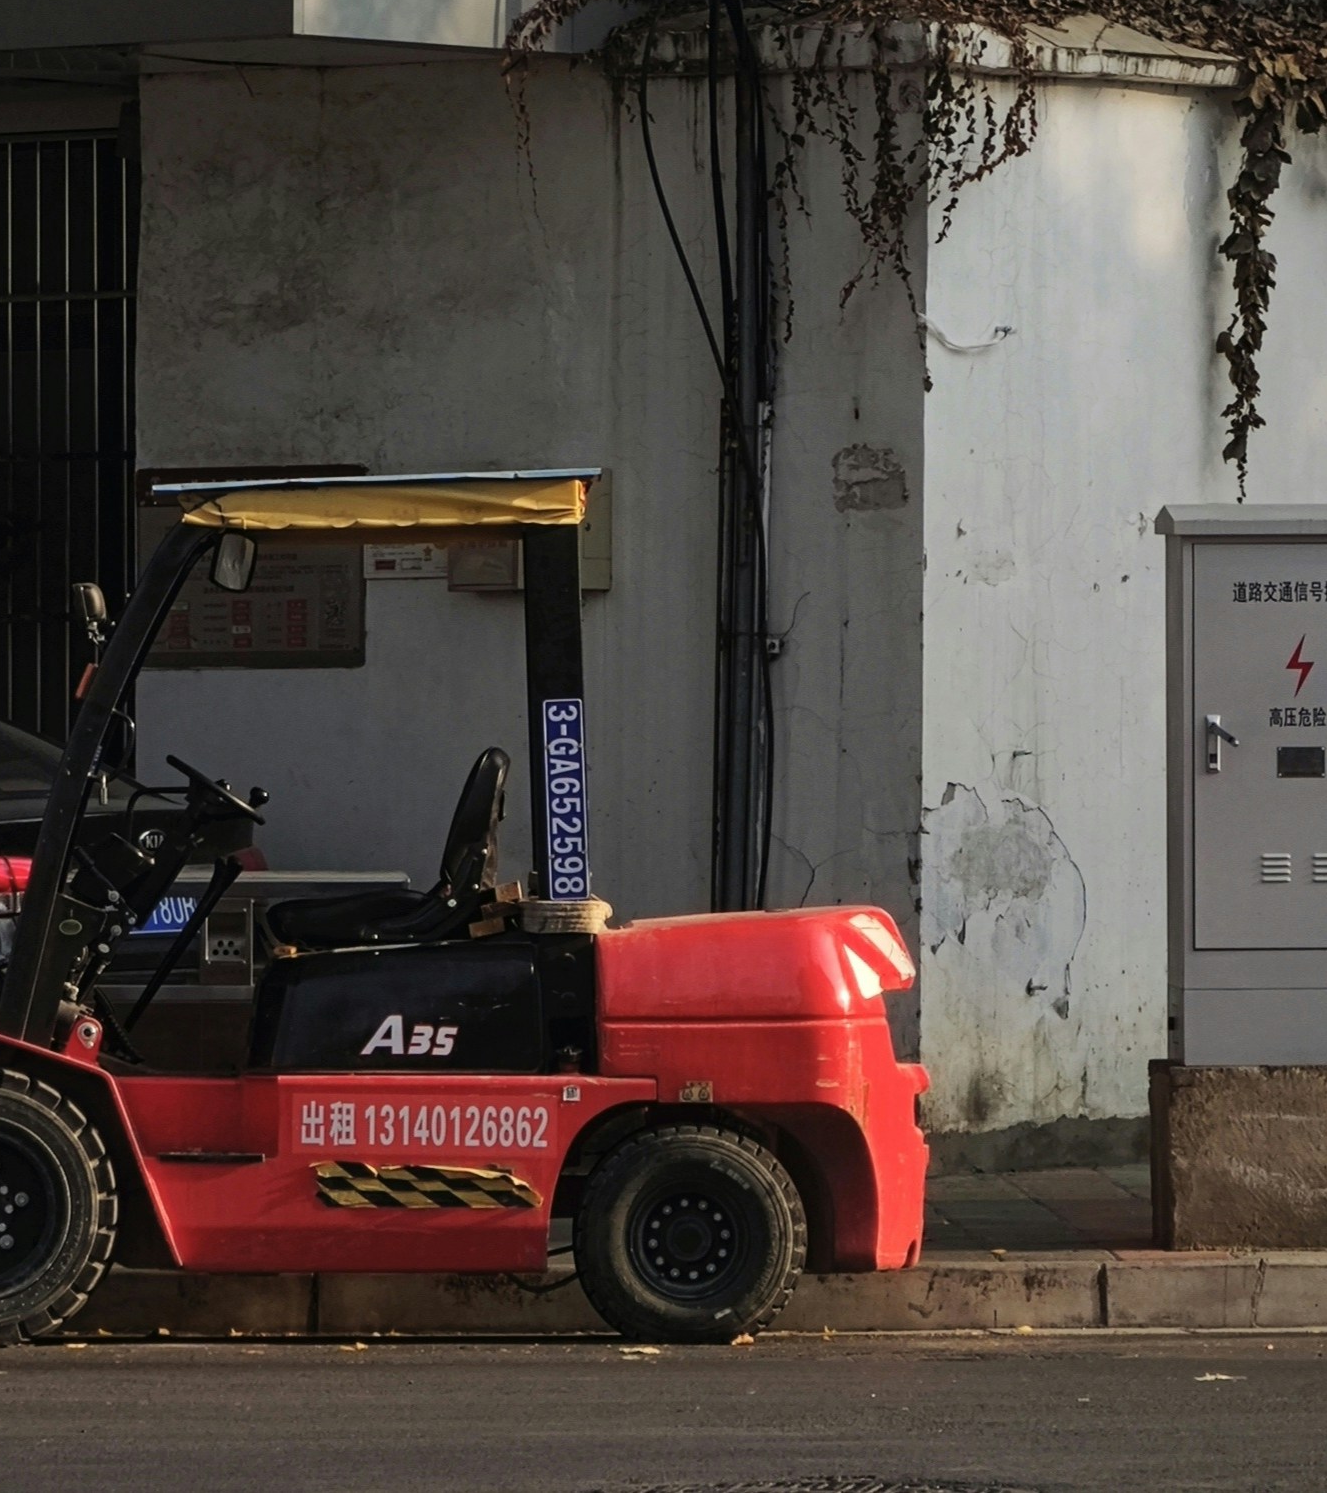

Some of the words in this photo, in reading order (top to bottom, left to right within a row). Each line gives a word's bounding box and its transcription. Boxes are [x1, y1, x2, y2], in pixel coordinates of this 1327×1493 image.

[1269, 708, 1327, 727] 高压危险
[548, 705, 585, 894] 3-GA652598
[360, 1014, 459, 1057] A35
[301, 1101, 357, 1147] 出租
[364, 1105, 549, 1148] 13140126862
